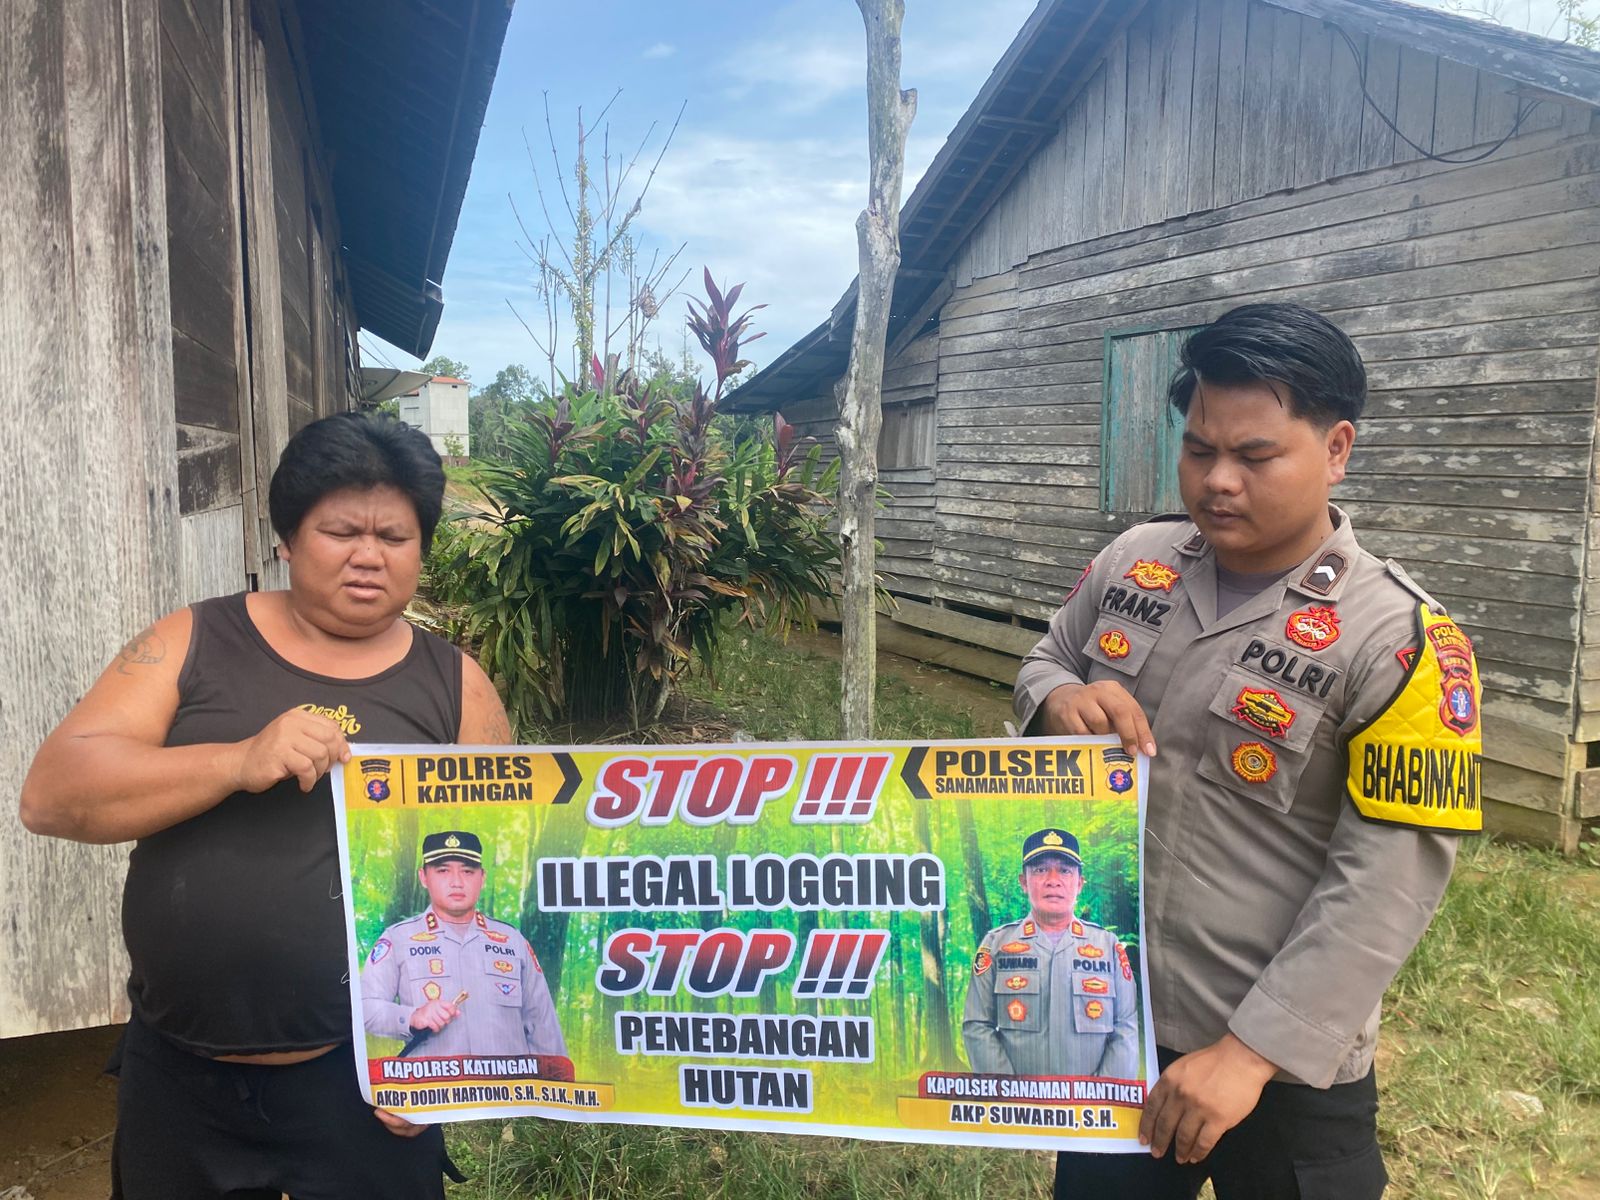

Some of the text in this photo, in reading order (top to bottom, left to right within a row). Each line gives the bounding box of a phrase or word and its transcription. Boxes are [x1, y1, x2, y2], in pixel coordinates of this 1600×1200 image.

[1102, 586, 1171, 626] FRANZ
[1241, 640, 1336, 698] POLRI
[417, 756, 532, 782] POLRES
[935, 750, 1083, 776] POLSEK
[418, 783, 532, 803] KATINGAN
[593, 757, 793, 819] STOP
[935, 777, 1085, 794] SANAMAN MANTIKEI
[542, 859, 940, 907] ILLEGAL LOGGING
[409, 946, 441, 956] DODIK
[485, 944, 515, 956] POLRI
[600, 932, 792, 993] STOP
[1073, 958, 1111, 973] POLRI
[620, 1016, 869, 1058] PENEBANGAN
[383, 1059, 538, 1078] KAPOLRES KATINGAN
[376, 1091, 407, 1107] AKBP
[411, 1089, 450, 1106] DODIK
[452, 1087, 513, 1103] HARTONO,
[575, 1090, 600, 1106] M.H.
[684, 1068, 808, 1108] HUTAN
[926, 1077, 1143, 1104] KAPOLSEK SANAMAN MANTIKEI
[951, 1105, 1117, 1128] AKP SUWARDI, S.H.
